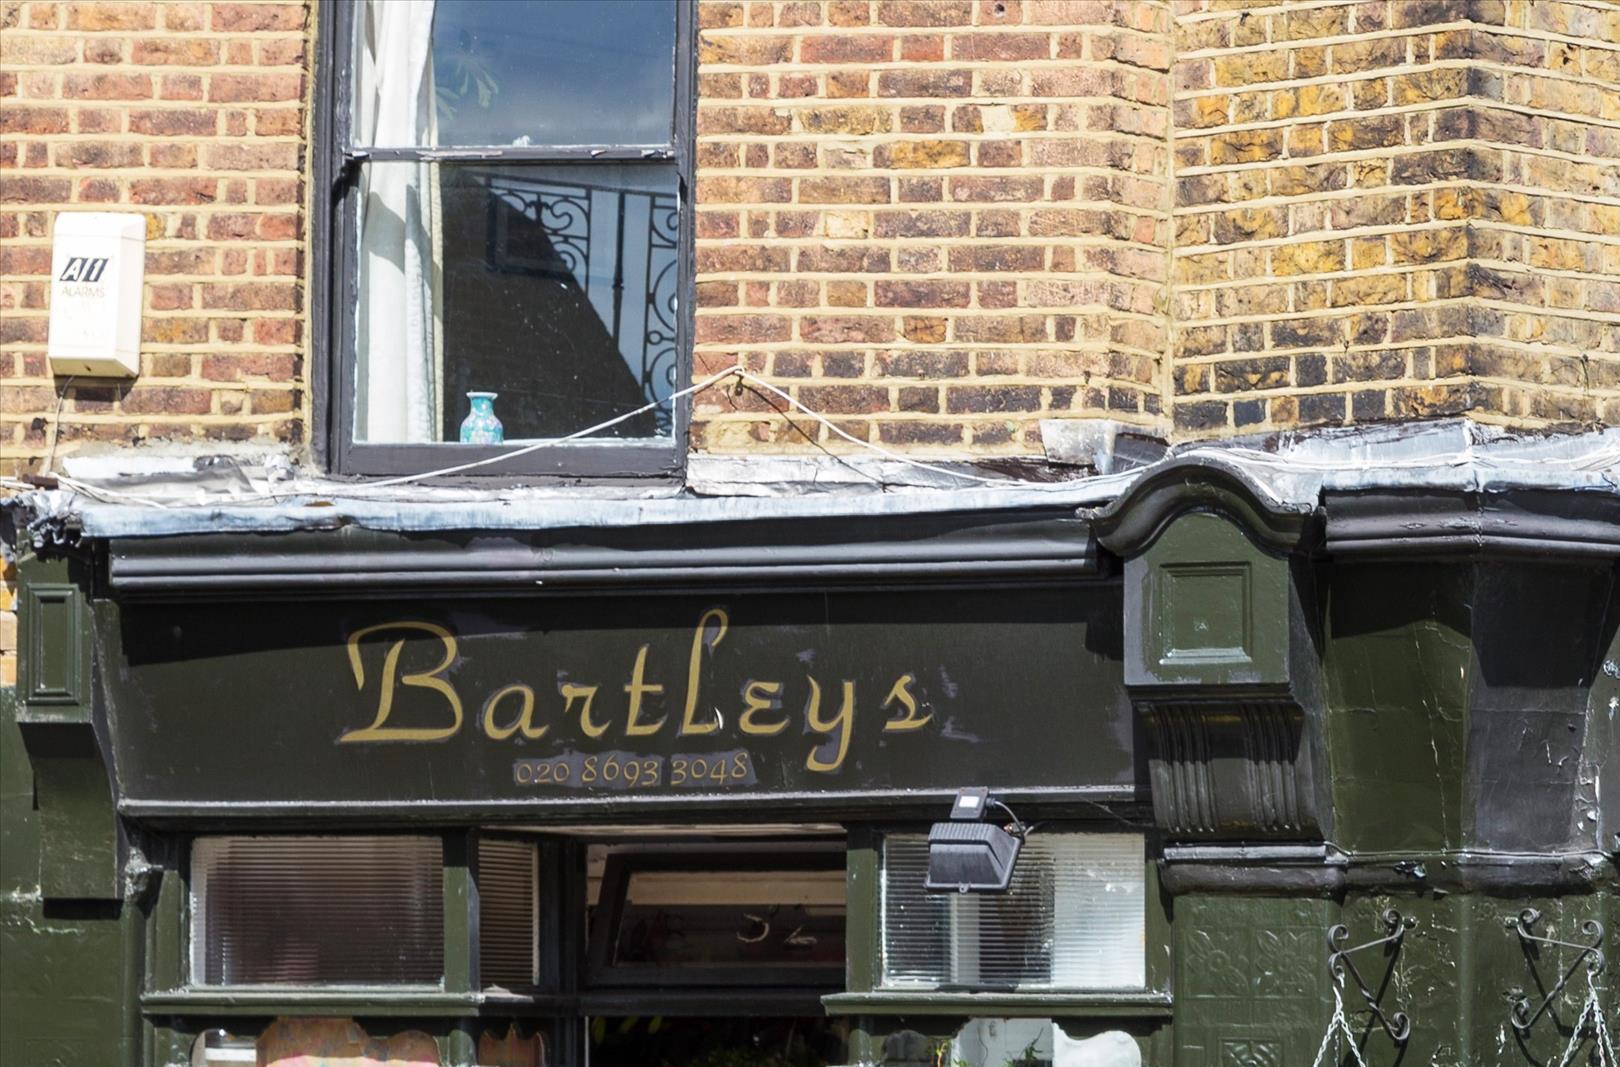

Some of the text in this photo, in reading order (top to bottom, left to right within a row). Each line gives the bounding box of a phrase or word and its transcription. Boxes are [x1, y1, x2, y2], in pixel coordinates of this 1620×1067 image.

[60, 257, 109, 282] A1
[61, 286, 105, 299] ALARMS
[336, 608, 932, 773] Bartleys
[516, 752, 748, 786] 020 8693 3048
